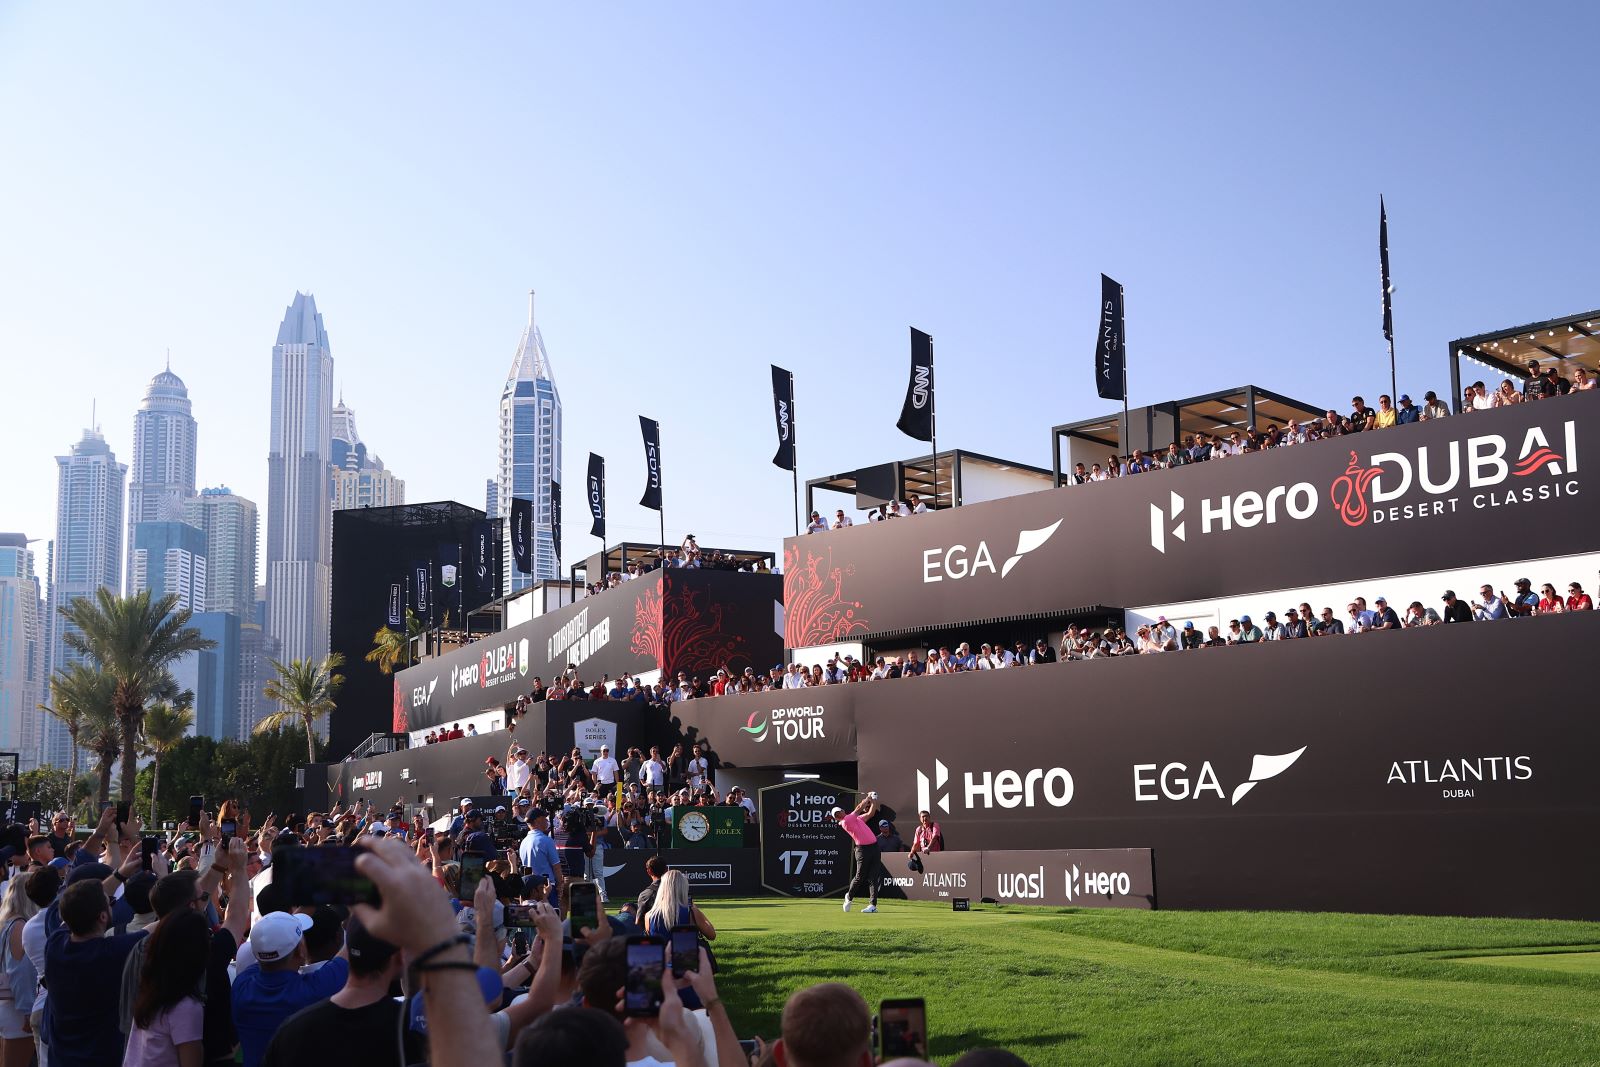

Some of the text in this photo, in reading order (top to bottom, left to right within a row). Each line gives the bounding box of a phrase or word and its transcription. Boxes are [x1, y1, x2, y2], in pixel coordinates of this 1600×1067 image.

[1103, 300, 1113, 379] ATLANTIS
[912, 365, 929, 409] CNN
[779, 400, 789, 441] CNN
[647, 441, 659, 488] wasl
[1370, 420, 1578, 503] DUBAI
[590, 475, 602, 519] wasl
[1202, 481, 1319, 534] Hero
[1373, 480, 1579, 524] DESERT CLASSIC
[923, 540, 997, 583] EGA
[459, 663, 479, 689] Hero
[485, 641, 517, 677] DUBAI
[413, 685, 427, 707] EGA
[772, 705, 824, 720] DP WORLD
[772, 717, 826, 745] TOUR
[1133, 760, 1226, 802] EGA
[1386, 755, 1534, 785] ATLANTIS
[804, 795, 836, 805] Hero
[964, 766, 1075, 809] Hero
[1442, 788, 1475, 798] DUBAI
[708, 870, 727, 879] NBD
[778, 850, 809, 875] 17
[883, 877, 914, 887] DP WORLD
[922, 872, 967, 888] ATLANTIS
[997, 865, 1044, 899] wasl
[1084, 871, 1131, 896] Hero
